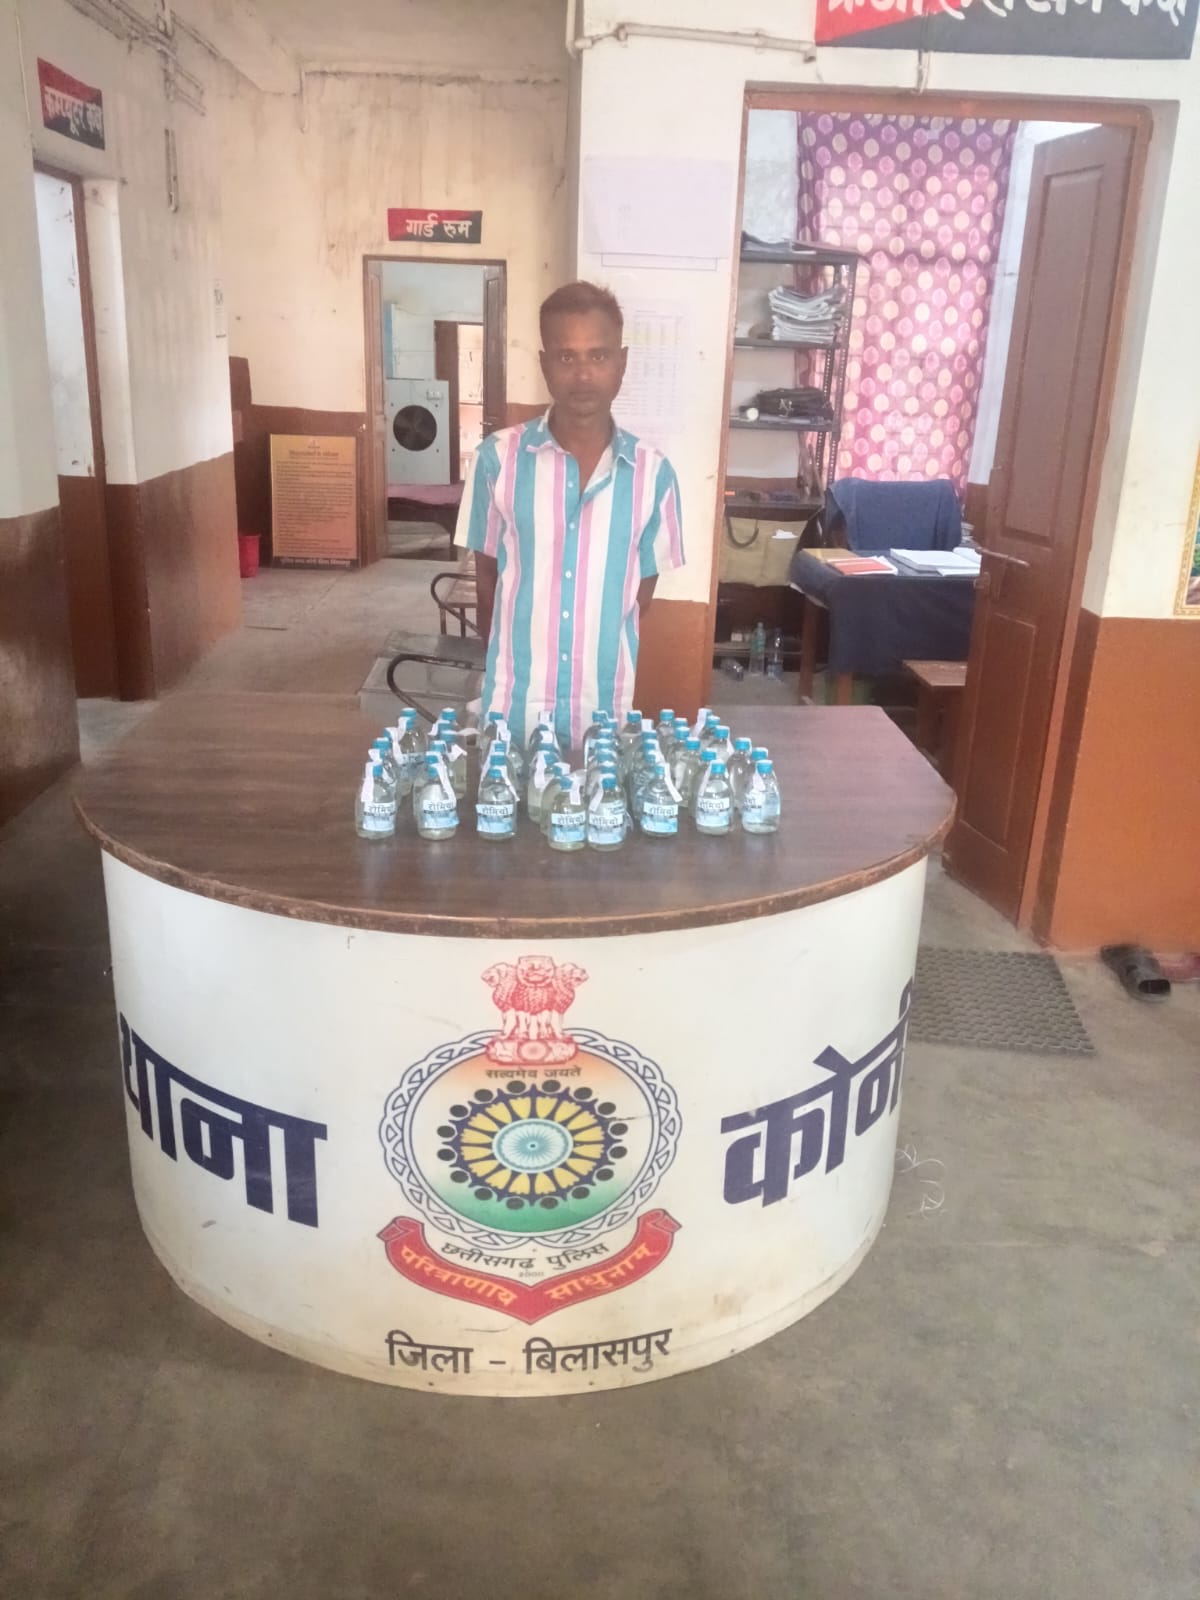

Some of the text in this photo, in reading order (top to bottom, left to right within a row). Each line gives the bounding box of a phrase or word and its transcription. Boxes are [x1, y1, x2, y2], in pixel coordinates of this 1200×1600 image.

[405, 213, 439, 238] गार्ड
[486, 1065, 582, 1078] सत्यमेव जयते
[547, 1243, 610, 1270] पुलिस
[385, 1330, 474, 1374] जिला
[522, 1328, 673, 1375] बिलासपुर
